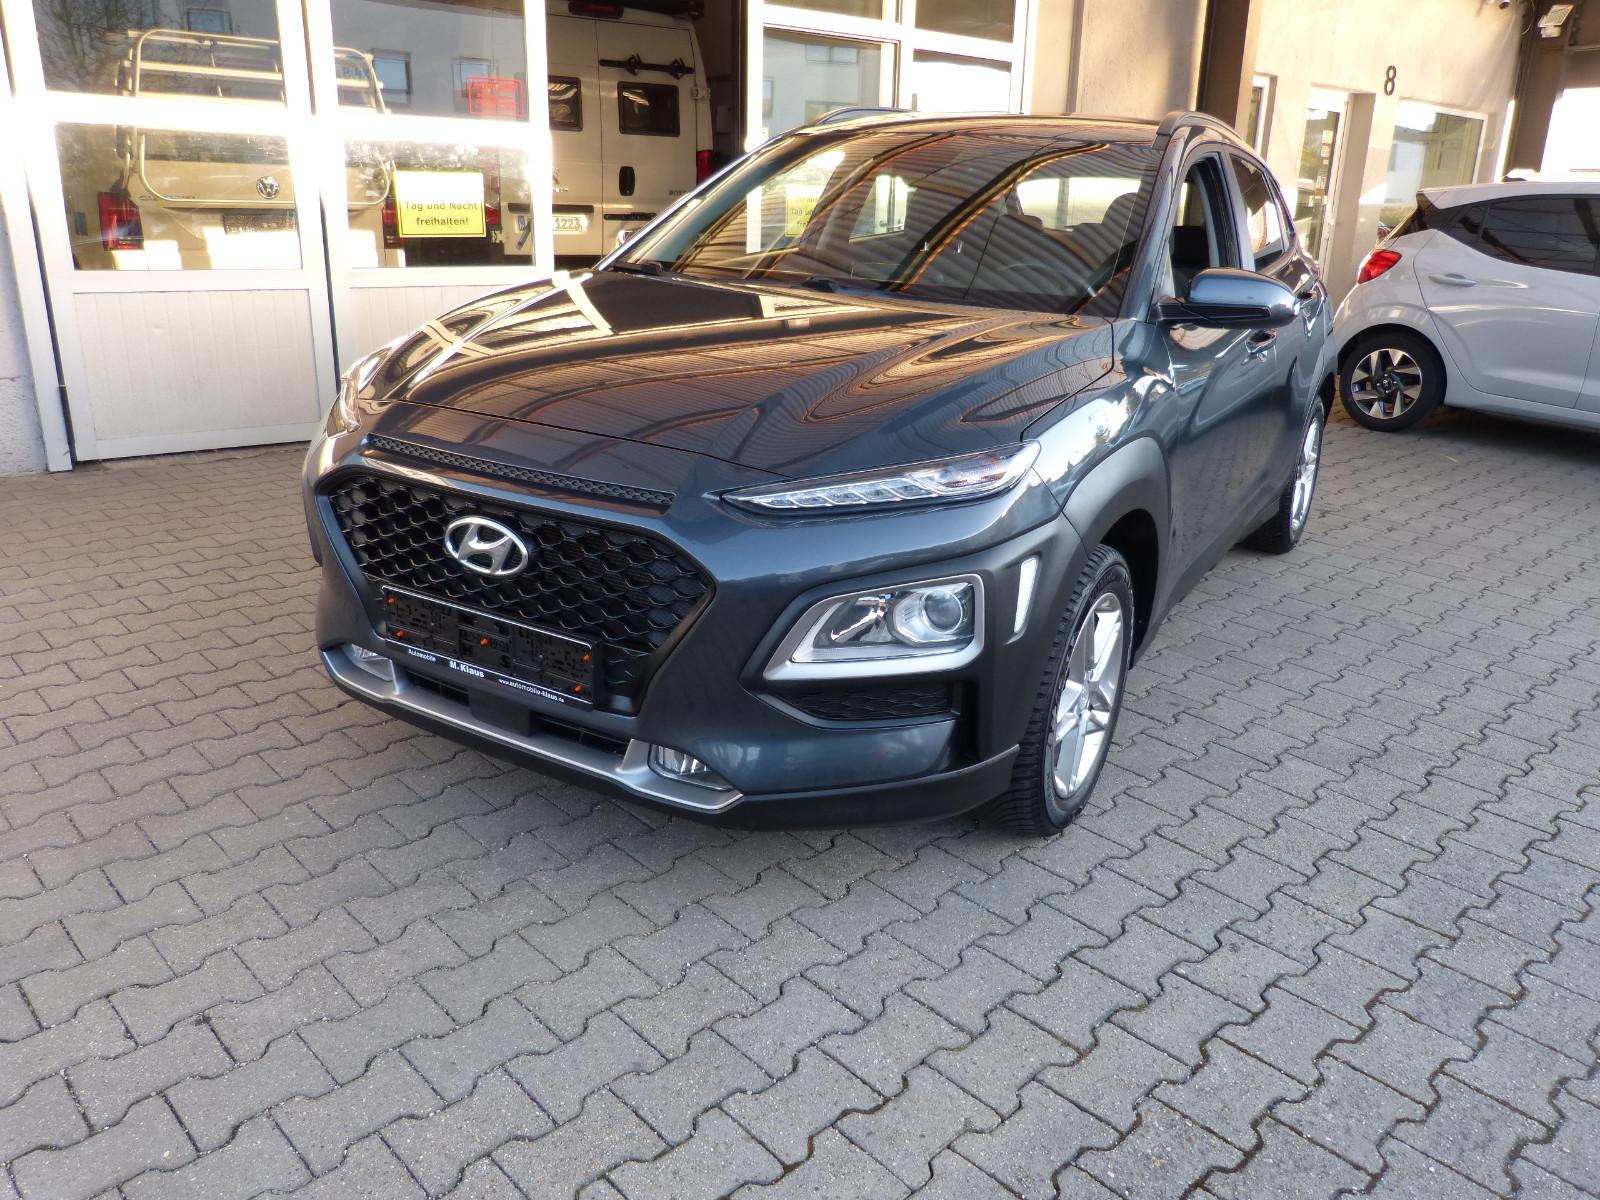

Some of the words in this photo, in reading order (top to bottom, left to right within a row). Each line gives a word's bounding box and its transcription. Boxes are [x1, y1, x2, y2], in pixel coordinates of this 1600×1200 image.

[1383, 65, 1397, 96] 8
[405, 202, 423, 212] Tag
[427, 202, 446, 210] und
[449, 202, 478, 210] Nacht
[416, 216, 469, 226] freihalten!
[408, 648, 436, 662] Automobile
